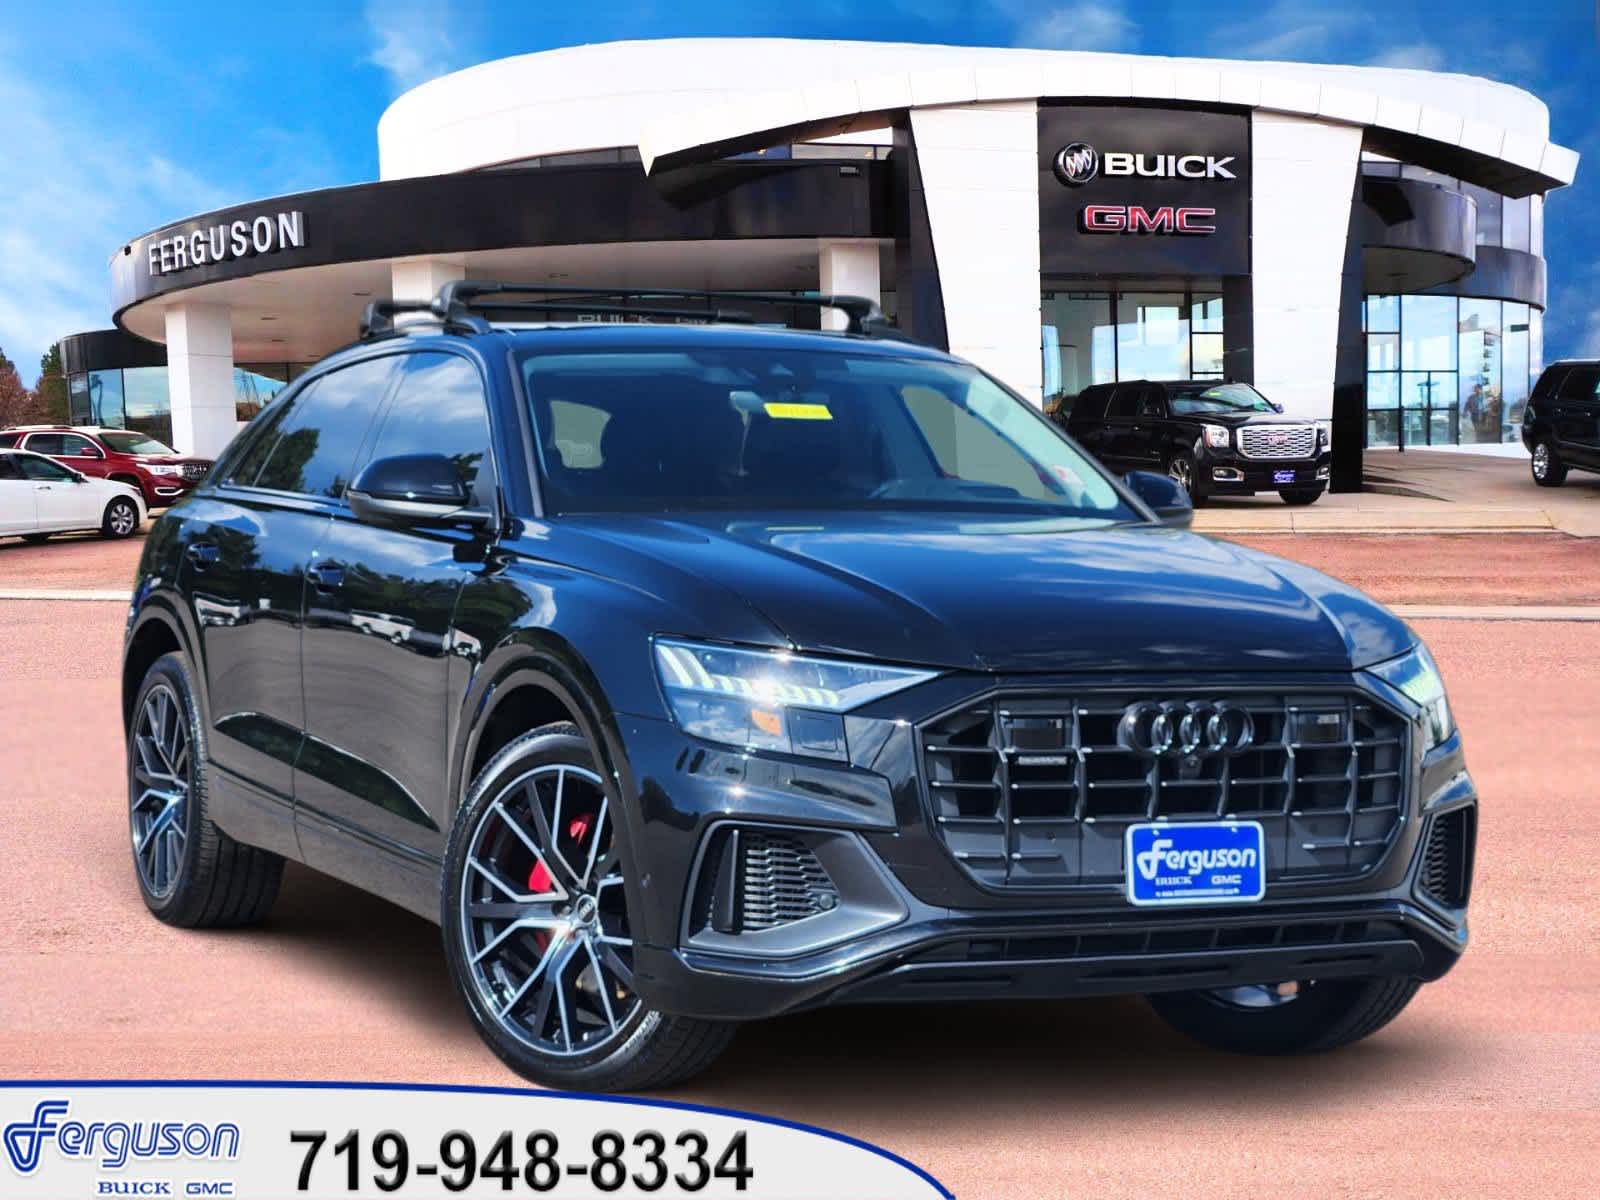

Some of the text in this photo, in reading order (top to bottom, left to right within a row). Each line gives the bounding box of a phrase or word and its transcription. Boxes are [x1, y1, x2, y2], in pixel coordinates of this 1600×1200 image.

[1104, 152, 1237, 179] BUICK
[1085, 205, 1216, 233] GMC
[148, 211, 305, 276] FERGUSON
[1136, 839, 1257, 880] Ferguson
